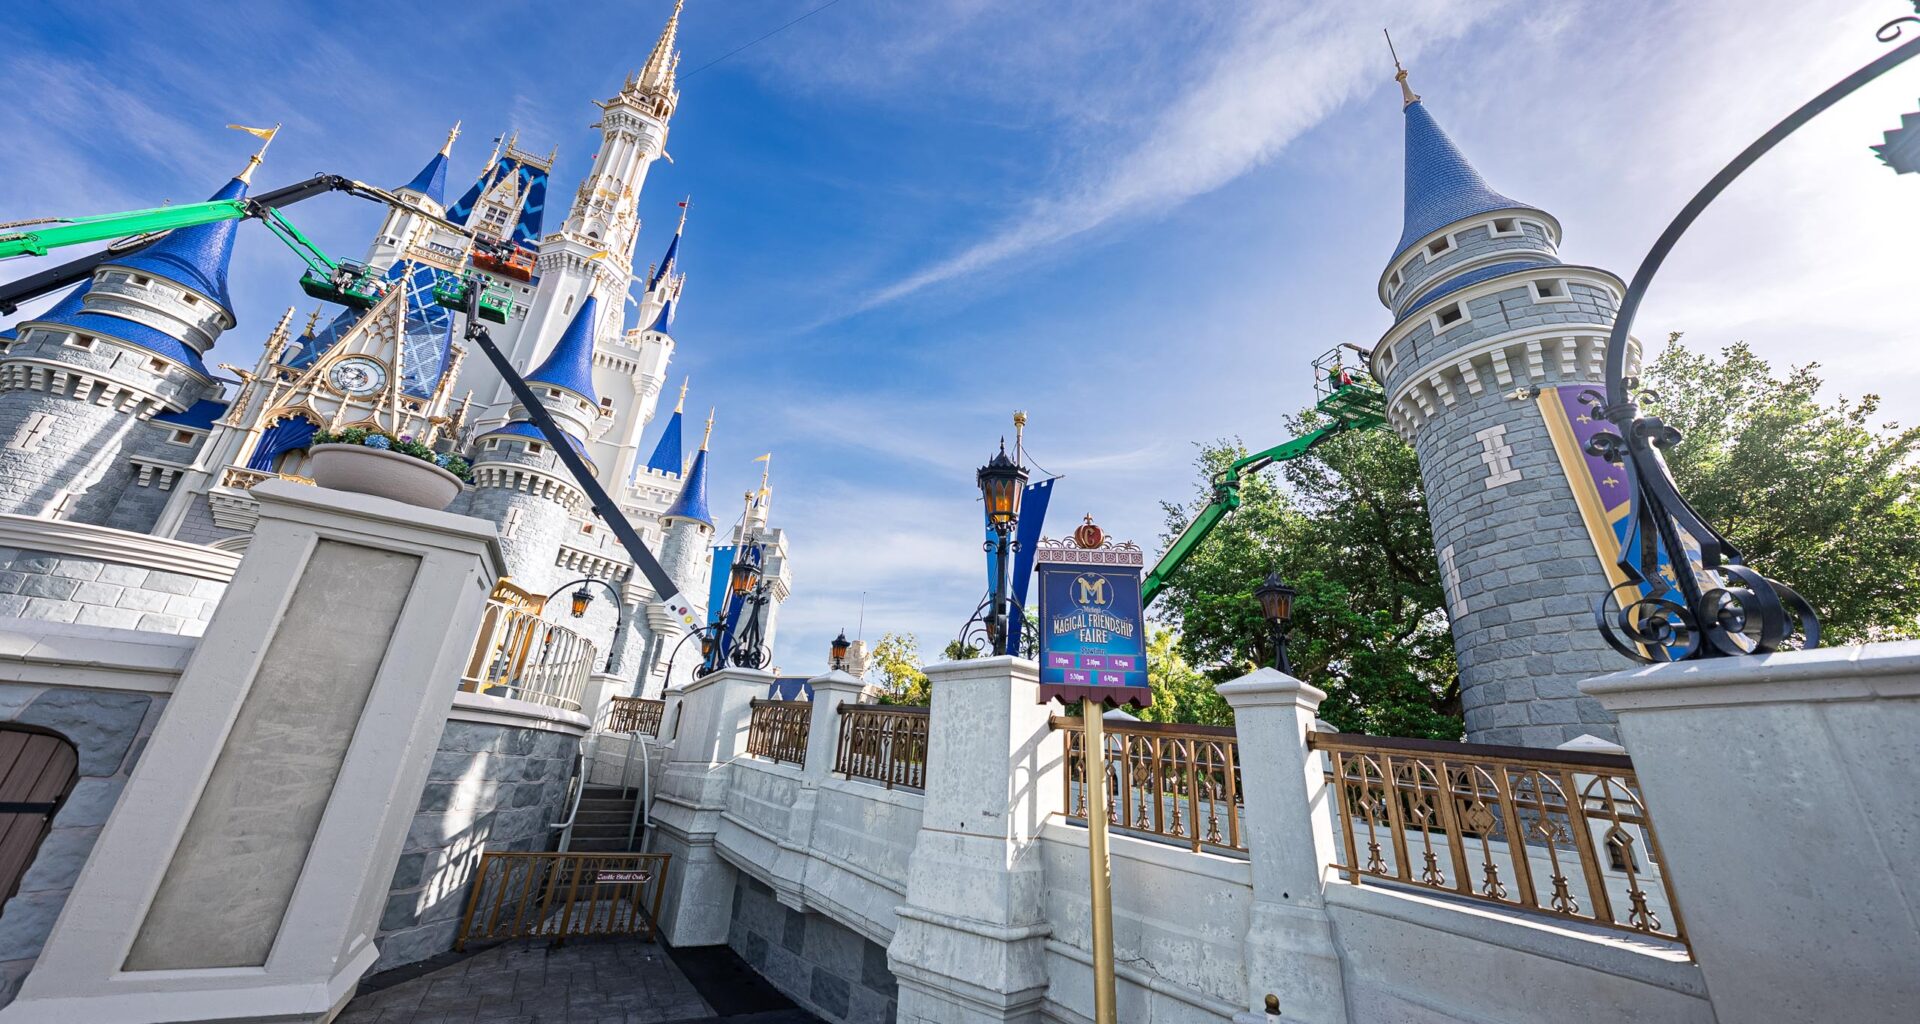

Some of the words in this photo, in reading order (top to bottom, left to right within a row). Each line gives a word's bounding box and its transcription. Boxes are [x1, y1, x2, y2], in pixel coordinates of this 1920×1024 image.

[1078, 577, 1106, 604] M
[1054, 613, 1087, 634] MAGICAL
[1088, 613, 1134, 638] FRIENDSHIP
[1080, 628, 1109, 644] FAIRE
